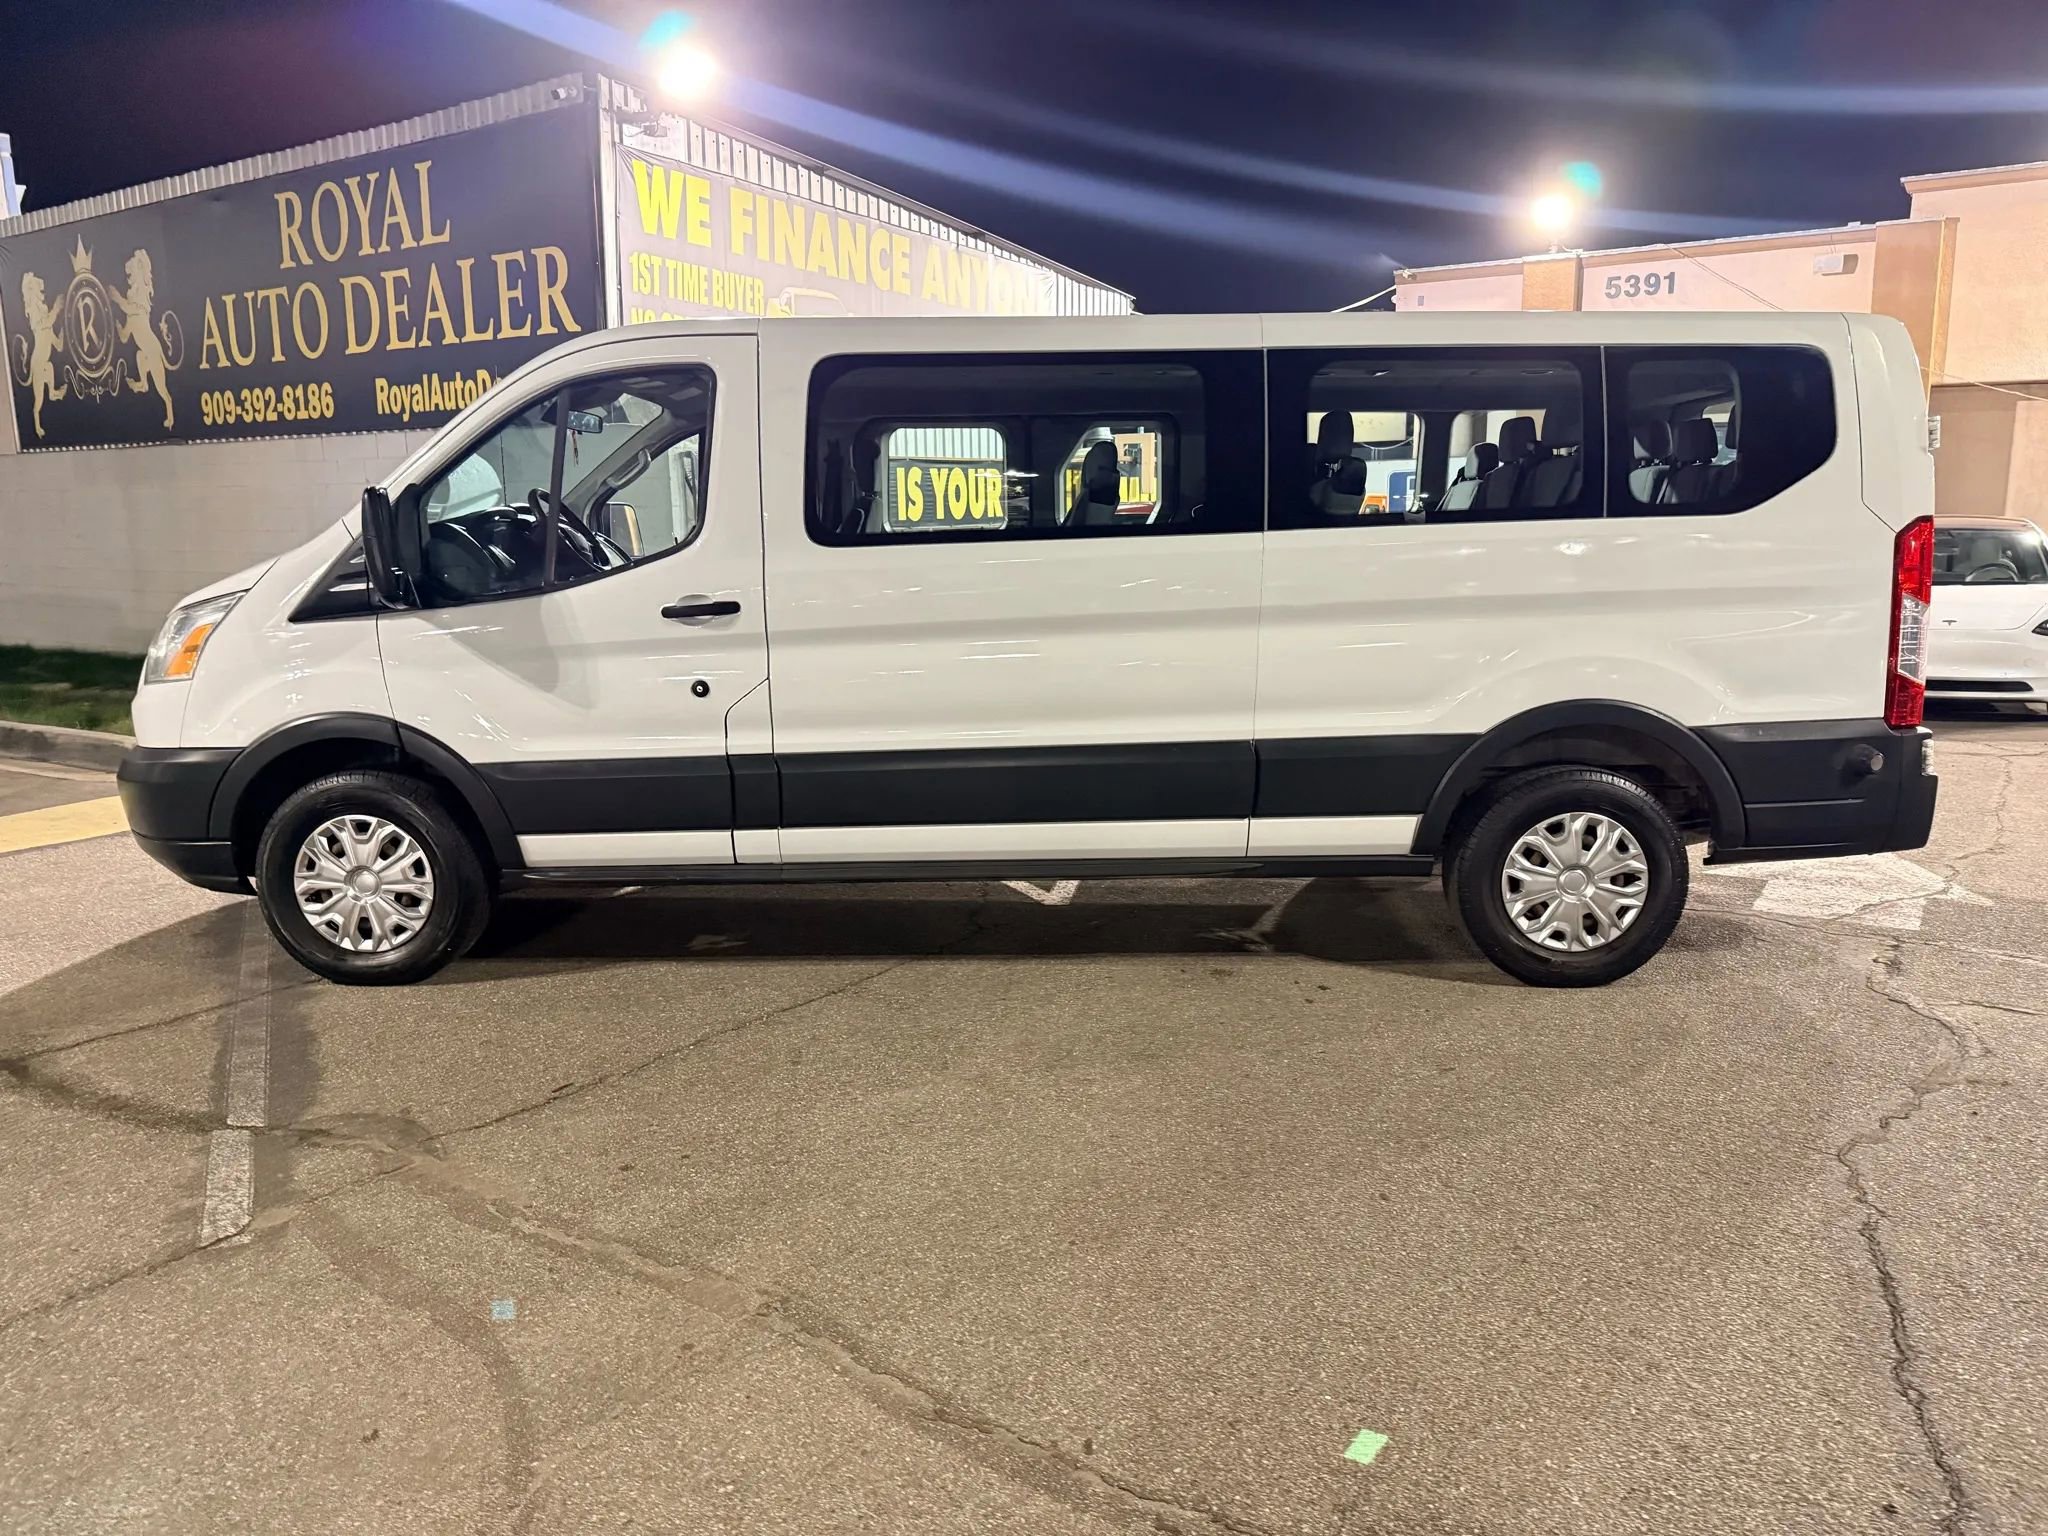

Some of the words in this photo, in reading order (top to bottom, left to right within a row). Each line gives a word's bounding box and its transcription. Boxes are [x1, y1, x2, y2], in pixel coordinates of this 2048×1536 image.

[274, 160, 450, 269] ROYAL
[632, 159, 712, 248] WE
[730, 186, 911, 296] FINANCE
[199, 281, 329, 369] AUTO
[339, 246, 582, 355] DEALER
[629, 251, 662, 296] 1ST
[665, 258, 708, 305] TIME
[712, 268, 764, 316] BUYER
[1605, 271, 1675, 299] 5391
[200, 382, 335, 426] 909-392-8186
[375, 369, 502, 422] RoyalAutoD
[896, 466, 923, 521] IS
[929, 466, 1003, 520] YOUR
